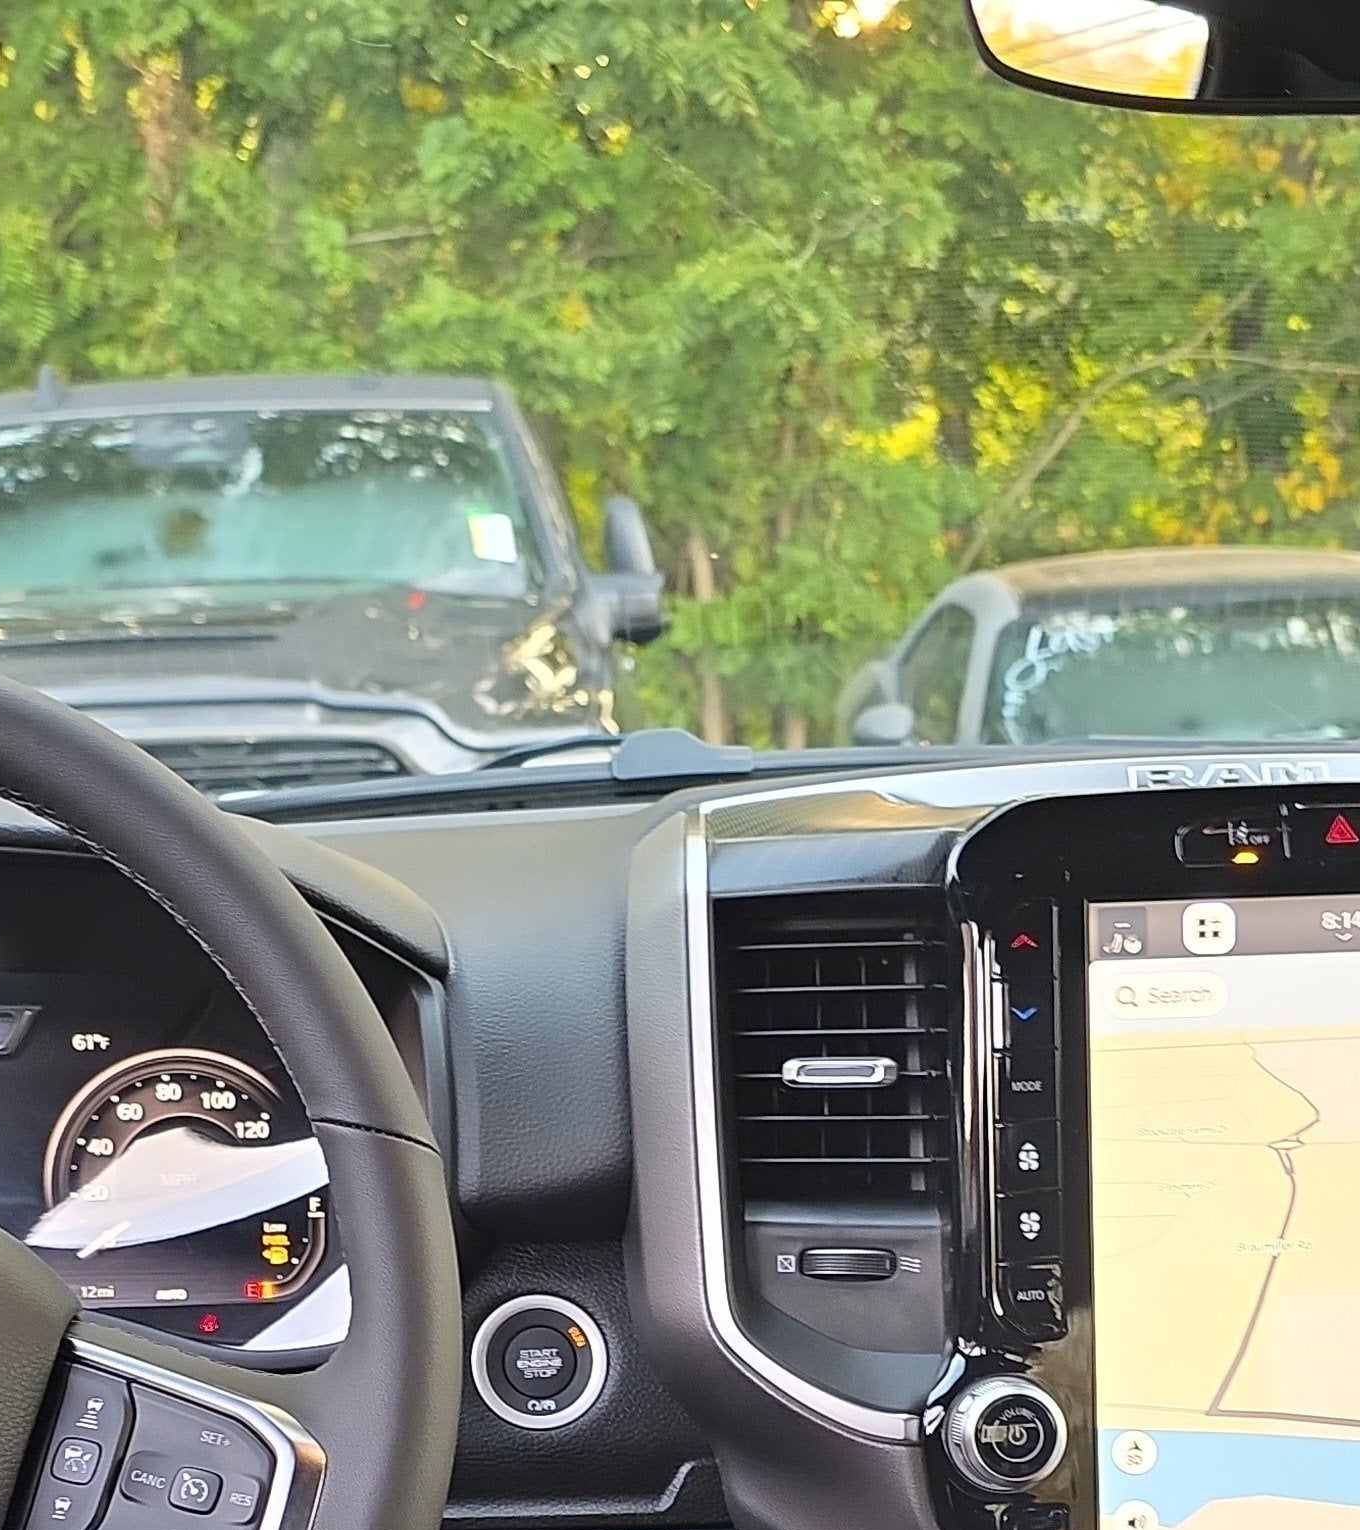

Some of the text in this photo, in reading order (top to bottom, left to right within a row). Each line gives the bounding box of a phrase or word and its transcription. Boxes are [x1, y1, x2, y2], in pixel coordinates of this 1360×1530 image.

[1127, 763, 1331, 789] RAM
[1148, 987, 1213, 1004] Search
[155, 1083, 182, 1102] 80
[1011, 1080, 1044, 1093] MODE
[200, 1091, 237, 1110] 100
[116, 1103, 144, 1121] 60
[235, 1121, 270, 1139] 120
[86, 1137, 114, 1156] 40
[81, 1184, 110, 1202] 20
[1016, 1289, 1046, 1302] AUTO
[520, 1348, 559, 1357] START
[523, 1369, 558, 1379] STOP
[130, 1469, 167, 1489] CANC
[229, 1492, 253, 1507] RES
